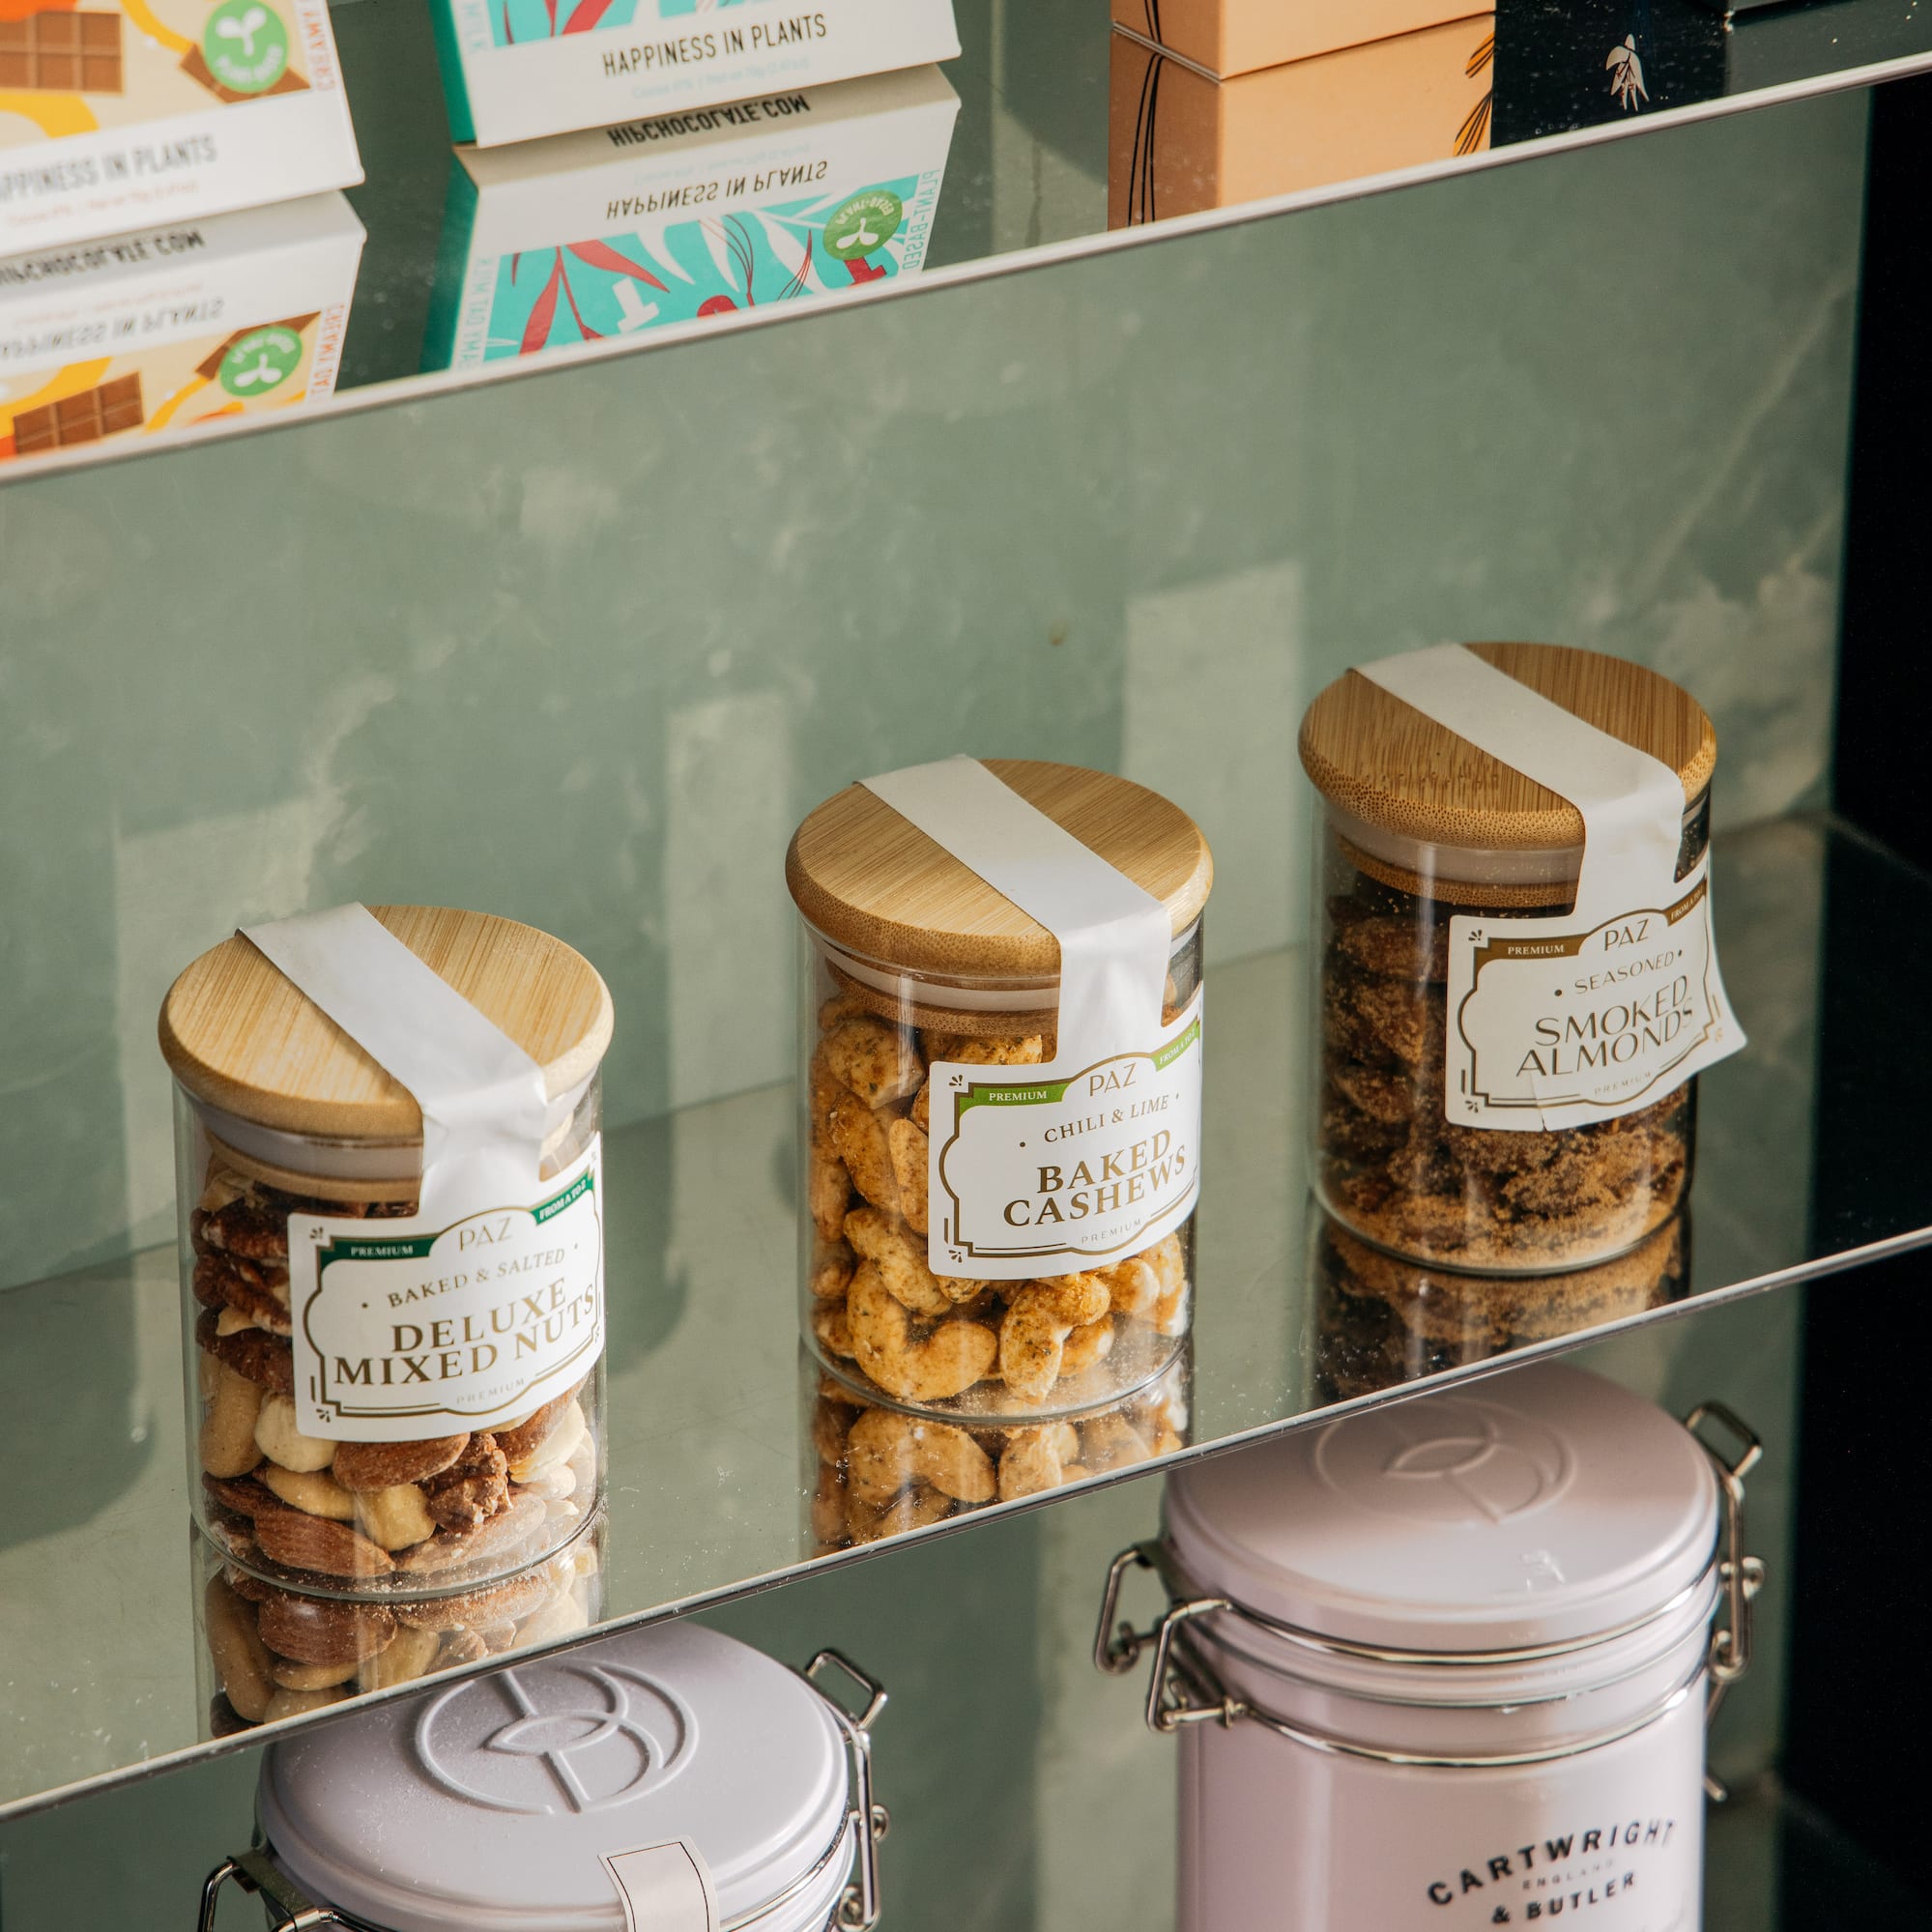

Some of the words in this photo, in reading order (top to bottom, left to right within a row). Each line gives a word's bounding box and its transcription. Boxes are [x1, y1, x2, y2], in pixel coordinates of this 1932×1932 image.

[602, 34, 716, 76] HAPPINESS
[724, 28, 744, 54] IN
[751, 14, 826, 48] PLANTS
[131, 132, 217, 177] PLANTS
[1507, 943, 1566, 955] PREMIUM
[1604, 918, 1650, 952] PAZ
[1574, 950, 1675, 995] SEASONED
[1535, 974, 1688, 1048] SMOKED
[1159, 1045, 1180, 1066] FROM
[1516, 996, 1693, 1078] ALMONDS
[989, 1090, 1048, 1102] PREMIUM
[1089, 1062, 1137, 1097] PAZ
[1044, 1112, 1106, 1143] CHILI
[1111, 1109, 1124, 1124] &
[1130, 1094, 1170, 1119] LIME
[1037, 1129, 1171, 1194] BAKED
[1003, 1144, 1186, 1226] CASHEWS
[539, 1197, 564, 1221] FROM
[1081, 1218, 1142, 1245] PREMIUM
[350, 1244, 414, 1256] PREMIUM
[459, 1217, 515, 1252] PAZ
[387, 1273, 468, 1308] BAKED
[476, 1269, 490, 1283] &
[496, 1248, 565, 1279] SALTED
[333, 1344, 499, 1385] MIXED
[514, 1283, 594, 1360] NUTS
[391, 1277, 566, 1352] DELUXE
[456, 1377, 525, 1404] PREMIUM
[1427, 1819, 1675, 1906] CARTWRIGHT
[1521, 1860, 1614, 1889] ENGLAND
[1491, 1904, 1510, 1924] &
[1526, 1871, 1635, 1920] BUTLER
